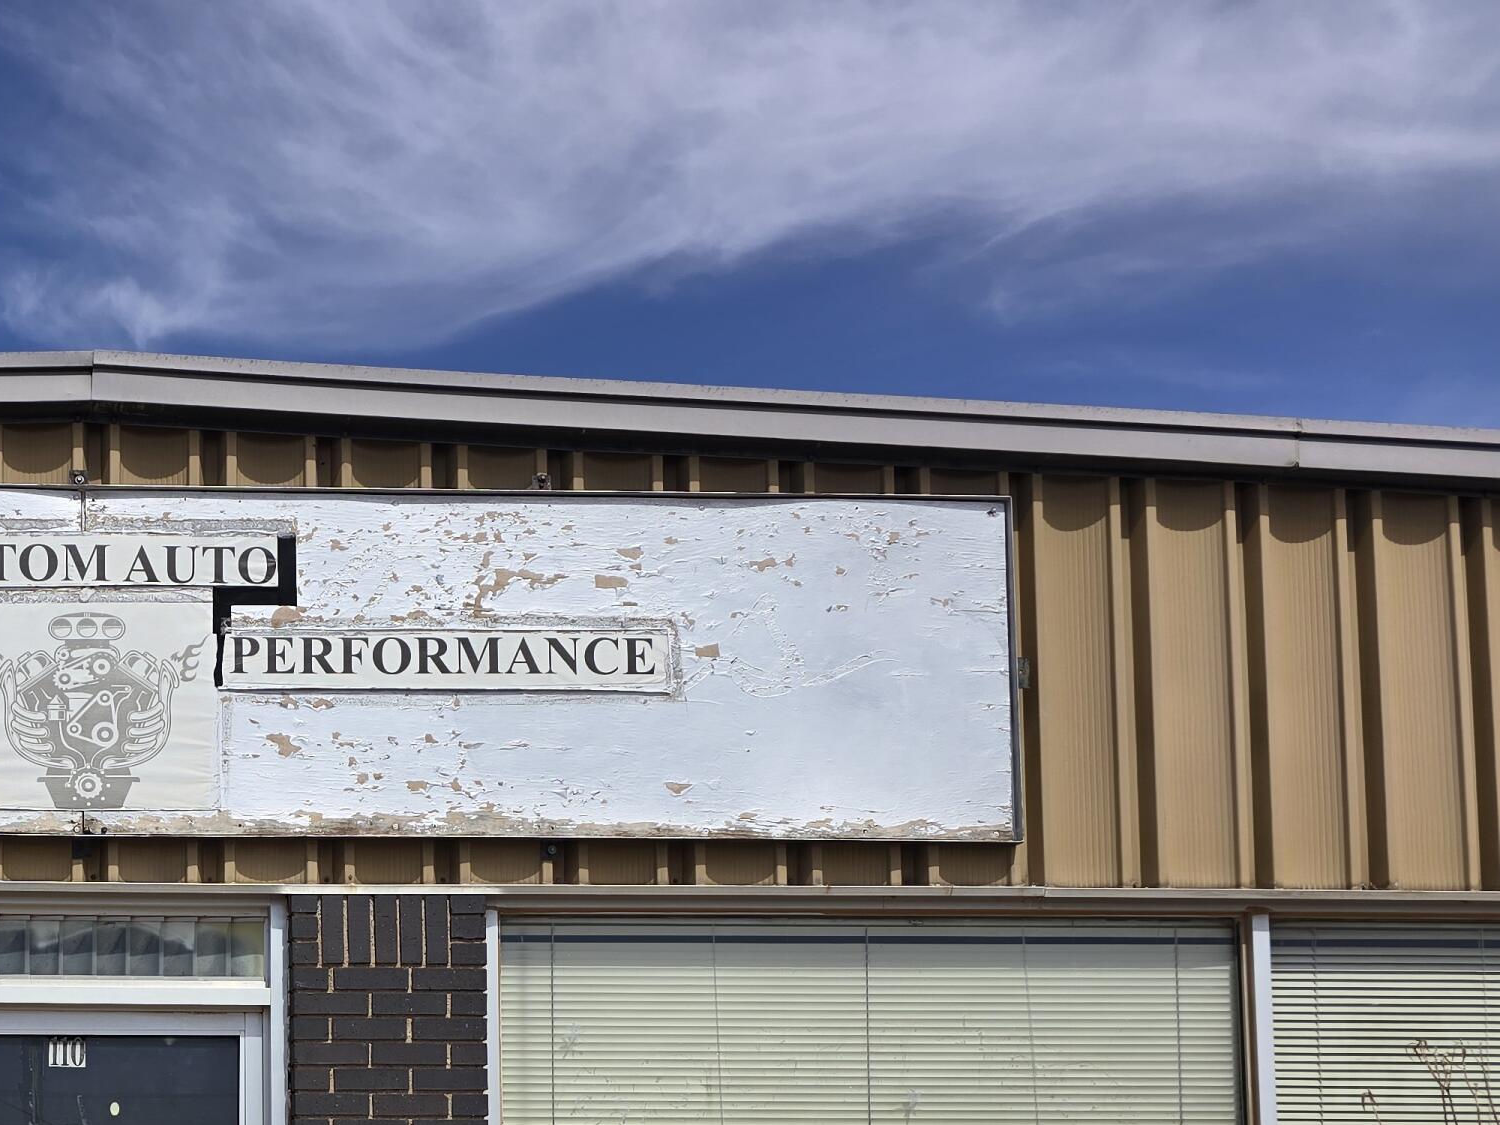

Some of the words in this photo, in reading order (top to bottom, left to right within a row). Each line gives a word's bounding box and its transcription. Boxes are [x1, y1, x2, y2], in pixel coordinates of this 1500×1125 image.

[125, 543, 277, 586] AUTO
[229, 636, 656, 677] PERFORMANCE
[49, 1036, 85, 1066] 110
